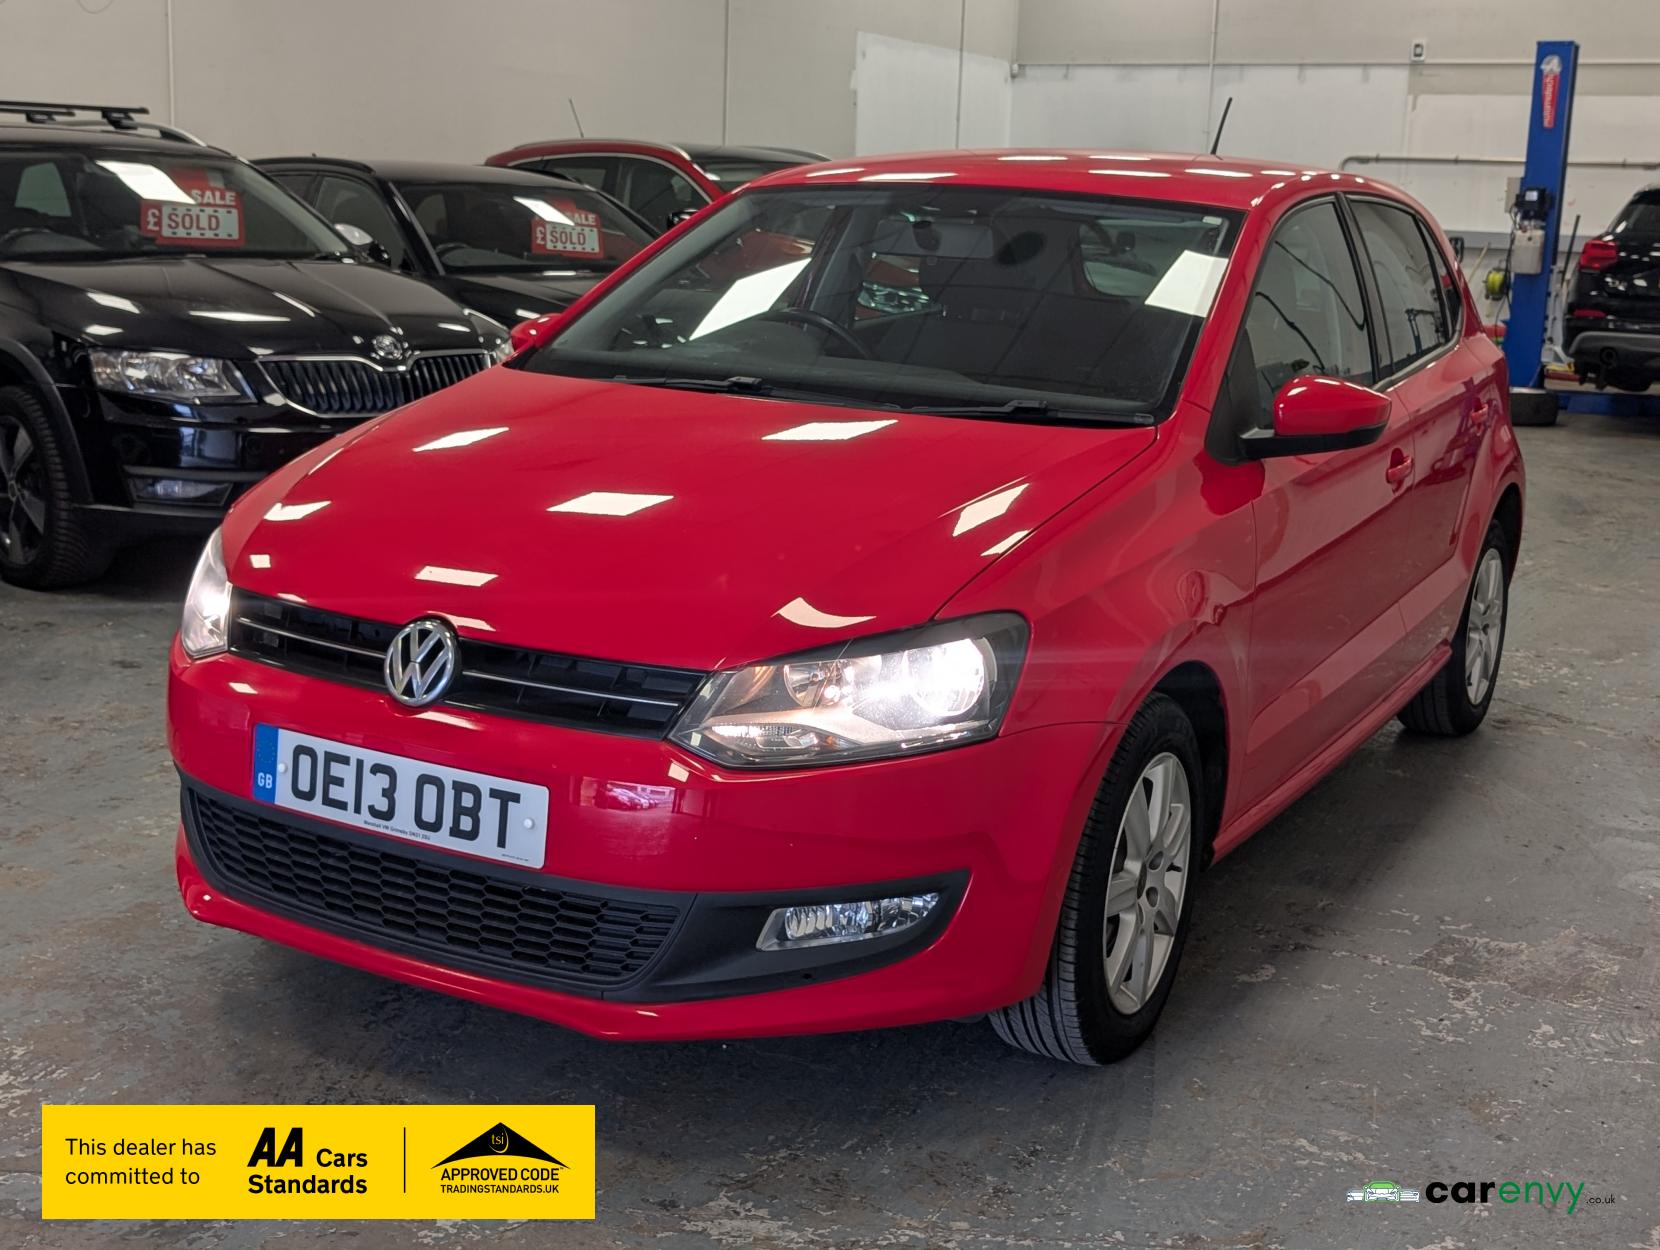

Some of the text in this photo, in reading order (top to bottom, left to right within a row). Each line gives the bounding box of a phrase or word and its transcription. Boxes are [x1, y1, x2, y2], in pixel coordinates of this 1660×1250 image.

[191, 189, 236, 205] SALE
[147, 208, 220, 231] £ SOLD
[536, 226, 586, 246] £ SOLD
[257, 772, 273, 789] GB
[291, 744, 521, 849] OE13 OBT
